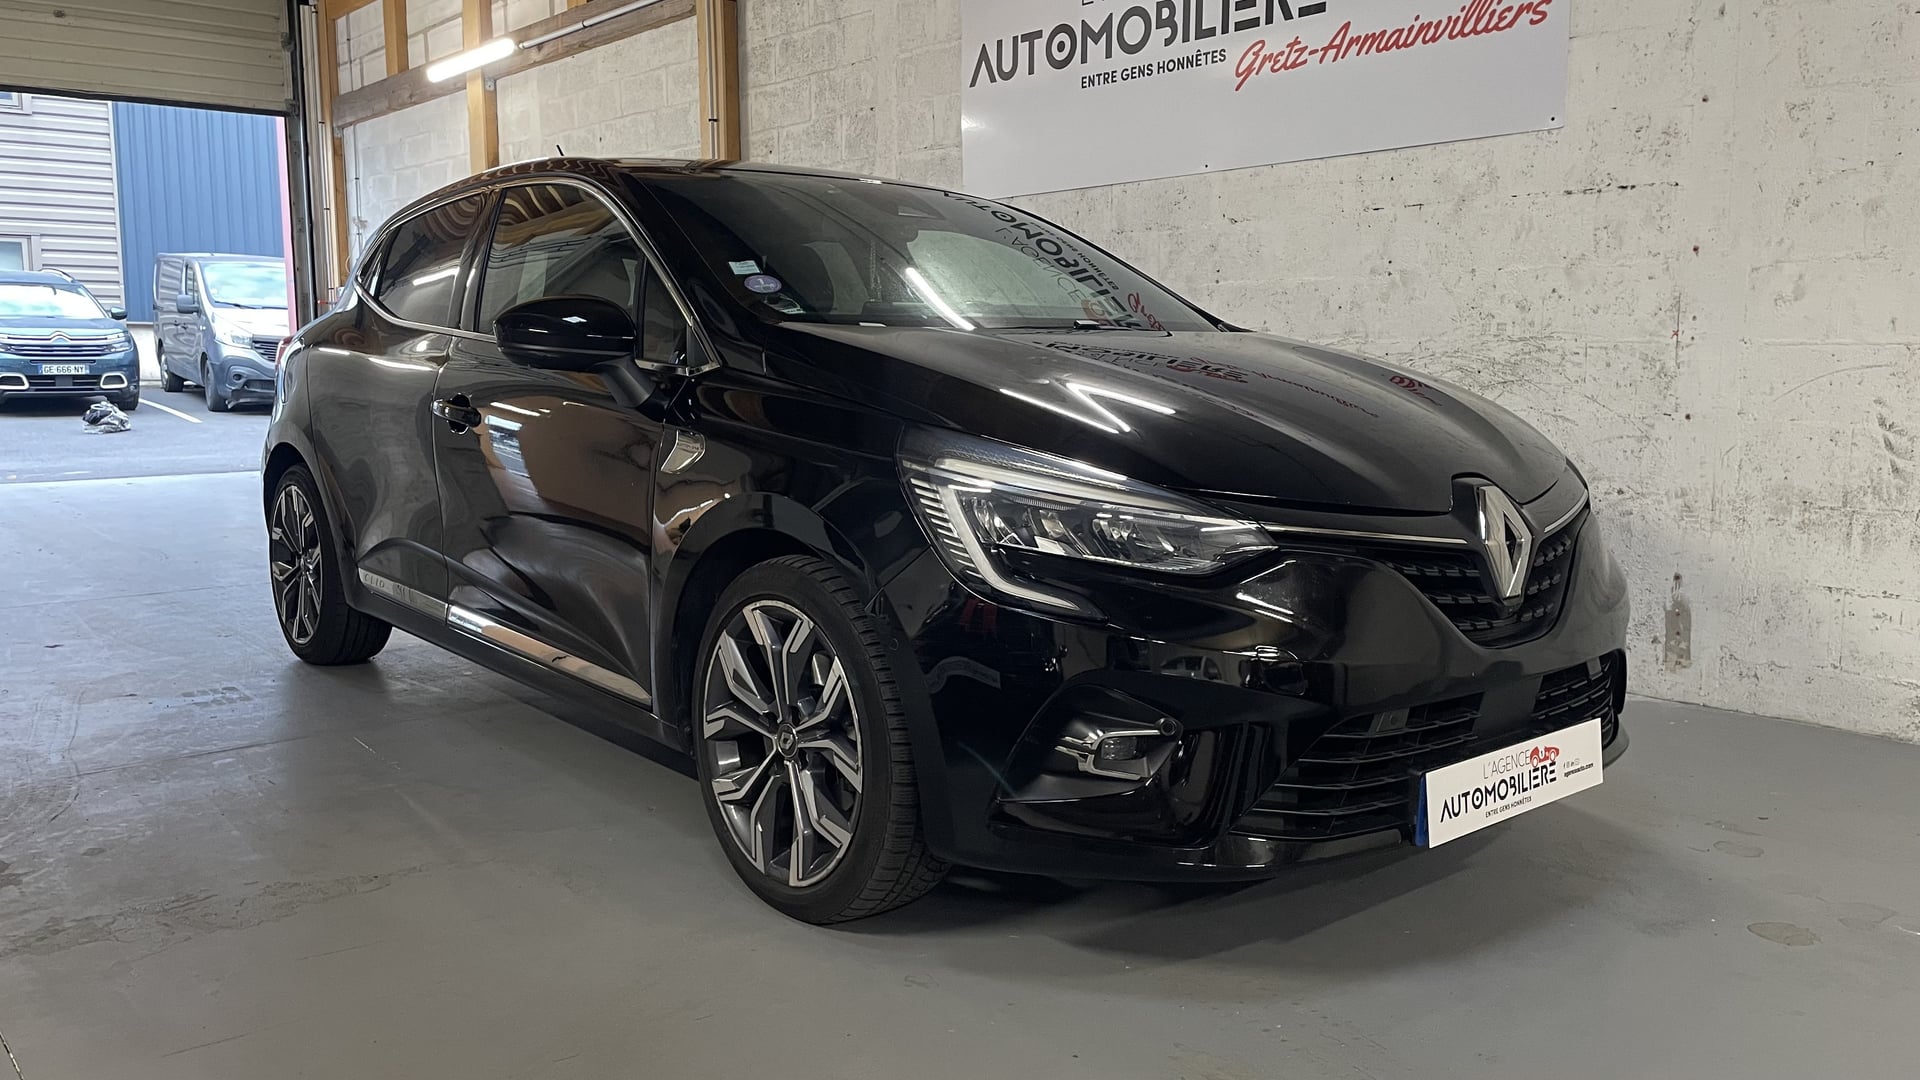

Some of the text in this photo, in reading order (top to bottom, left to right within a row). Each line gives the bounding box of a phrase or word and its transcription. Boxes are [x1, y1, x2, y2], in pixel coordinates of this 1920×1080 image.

[1081, 49, 1227, 89] ENTRE GENS HONNÊTES
[44, 365, 84, 374] GE 666 NY
[1482, 749, 1530, 779] L'AGENCE
[1485, 807, 1499, 818] ENTRE
[1499, 803, 1511, 813] GENS
